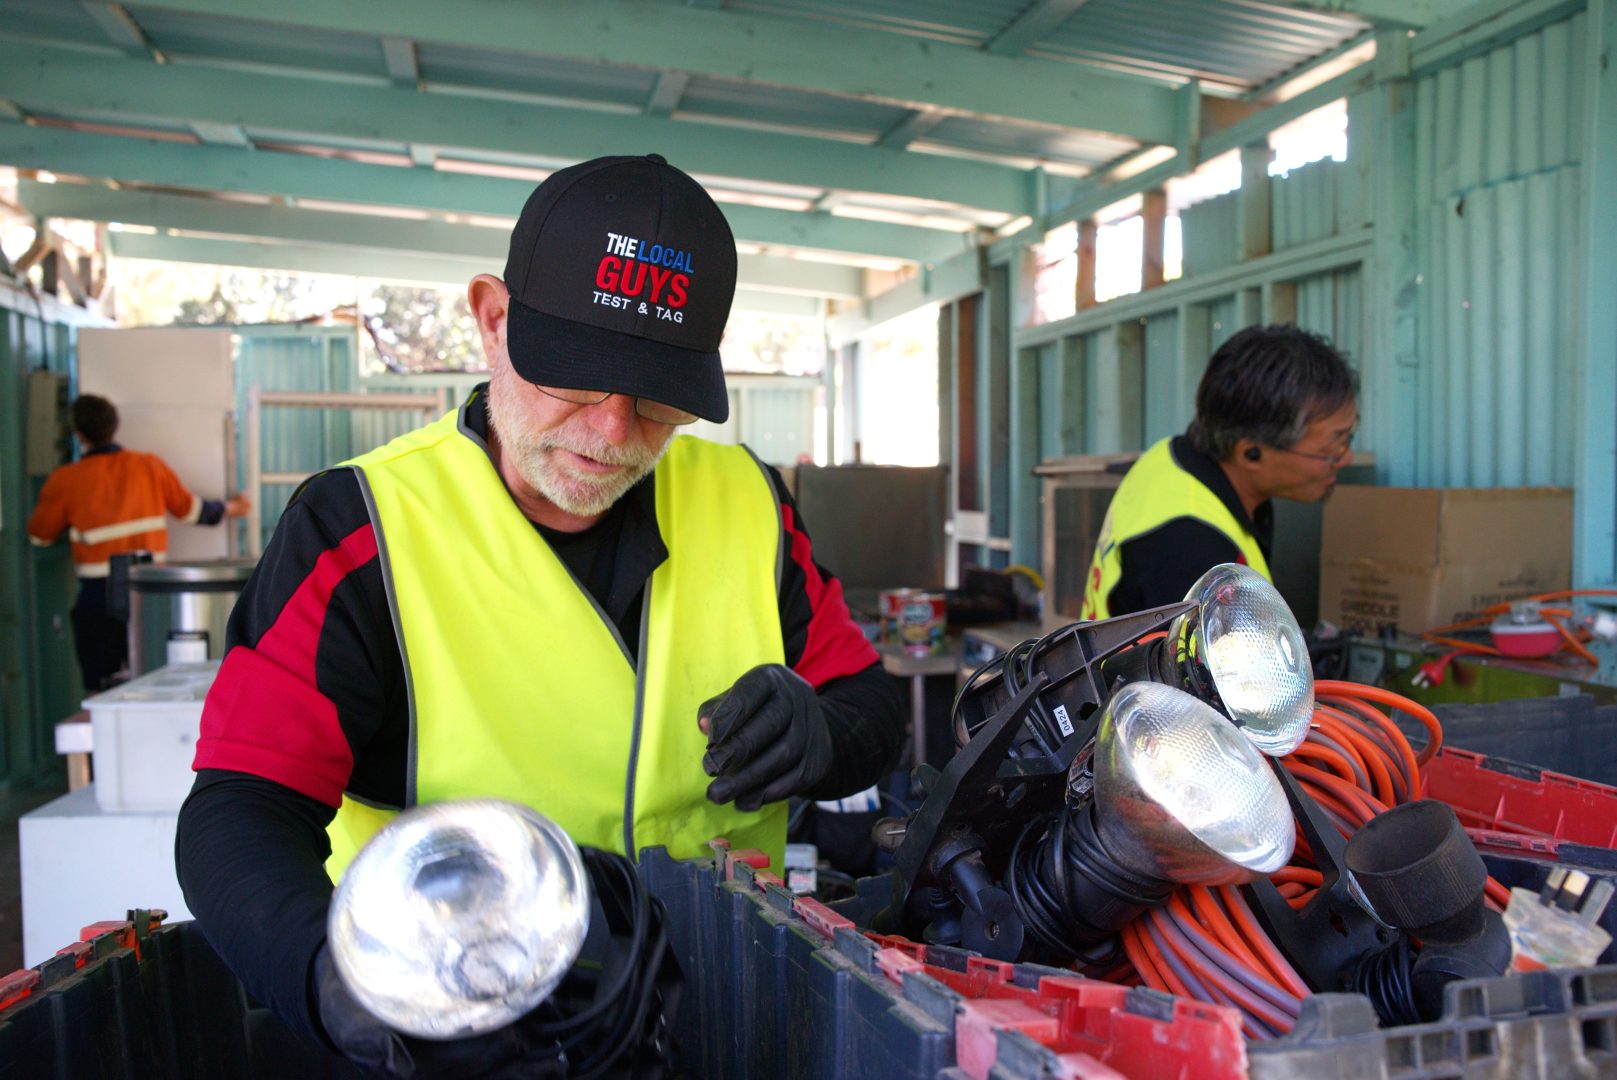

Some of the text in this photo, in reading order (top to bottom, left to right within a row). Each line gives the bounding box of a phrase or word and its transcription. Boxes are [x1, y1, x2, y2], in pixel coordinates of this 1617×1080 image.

[606, 232, 695, 274] THE LOCAL
[595, 255, 690, 308] GUYS
[593, 291, 683, 323] TEST & TAG
[1058, 709, 1071, 732] 0424
